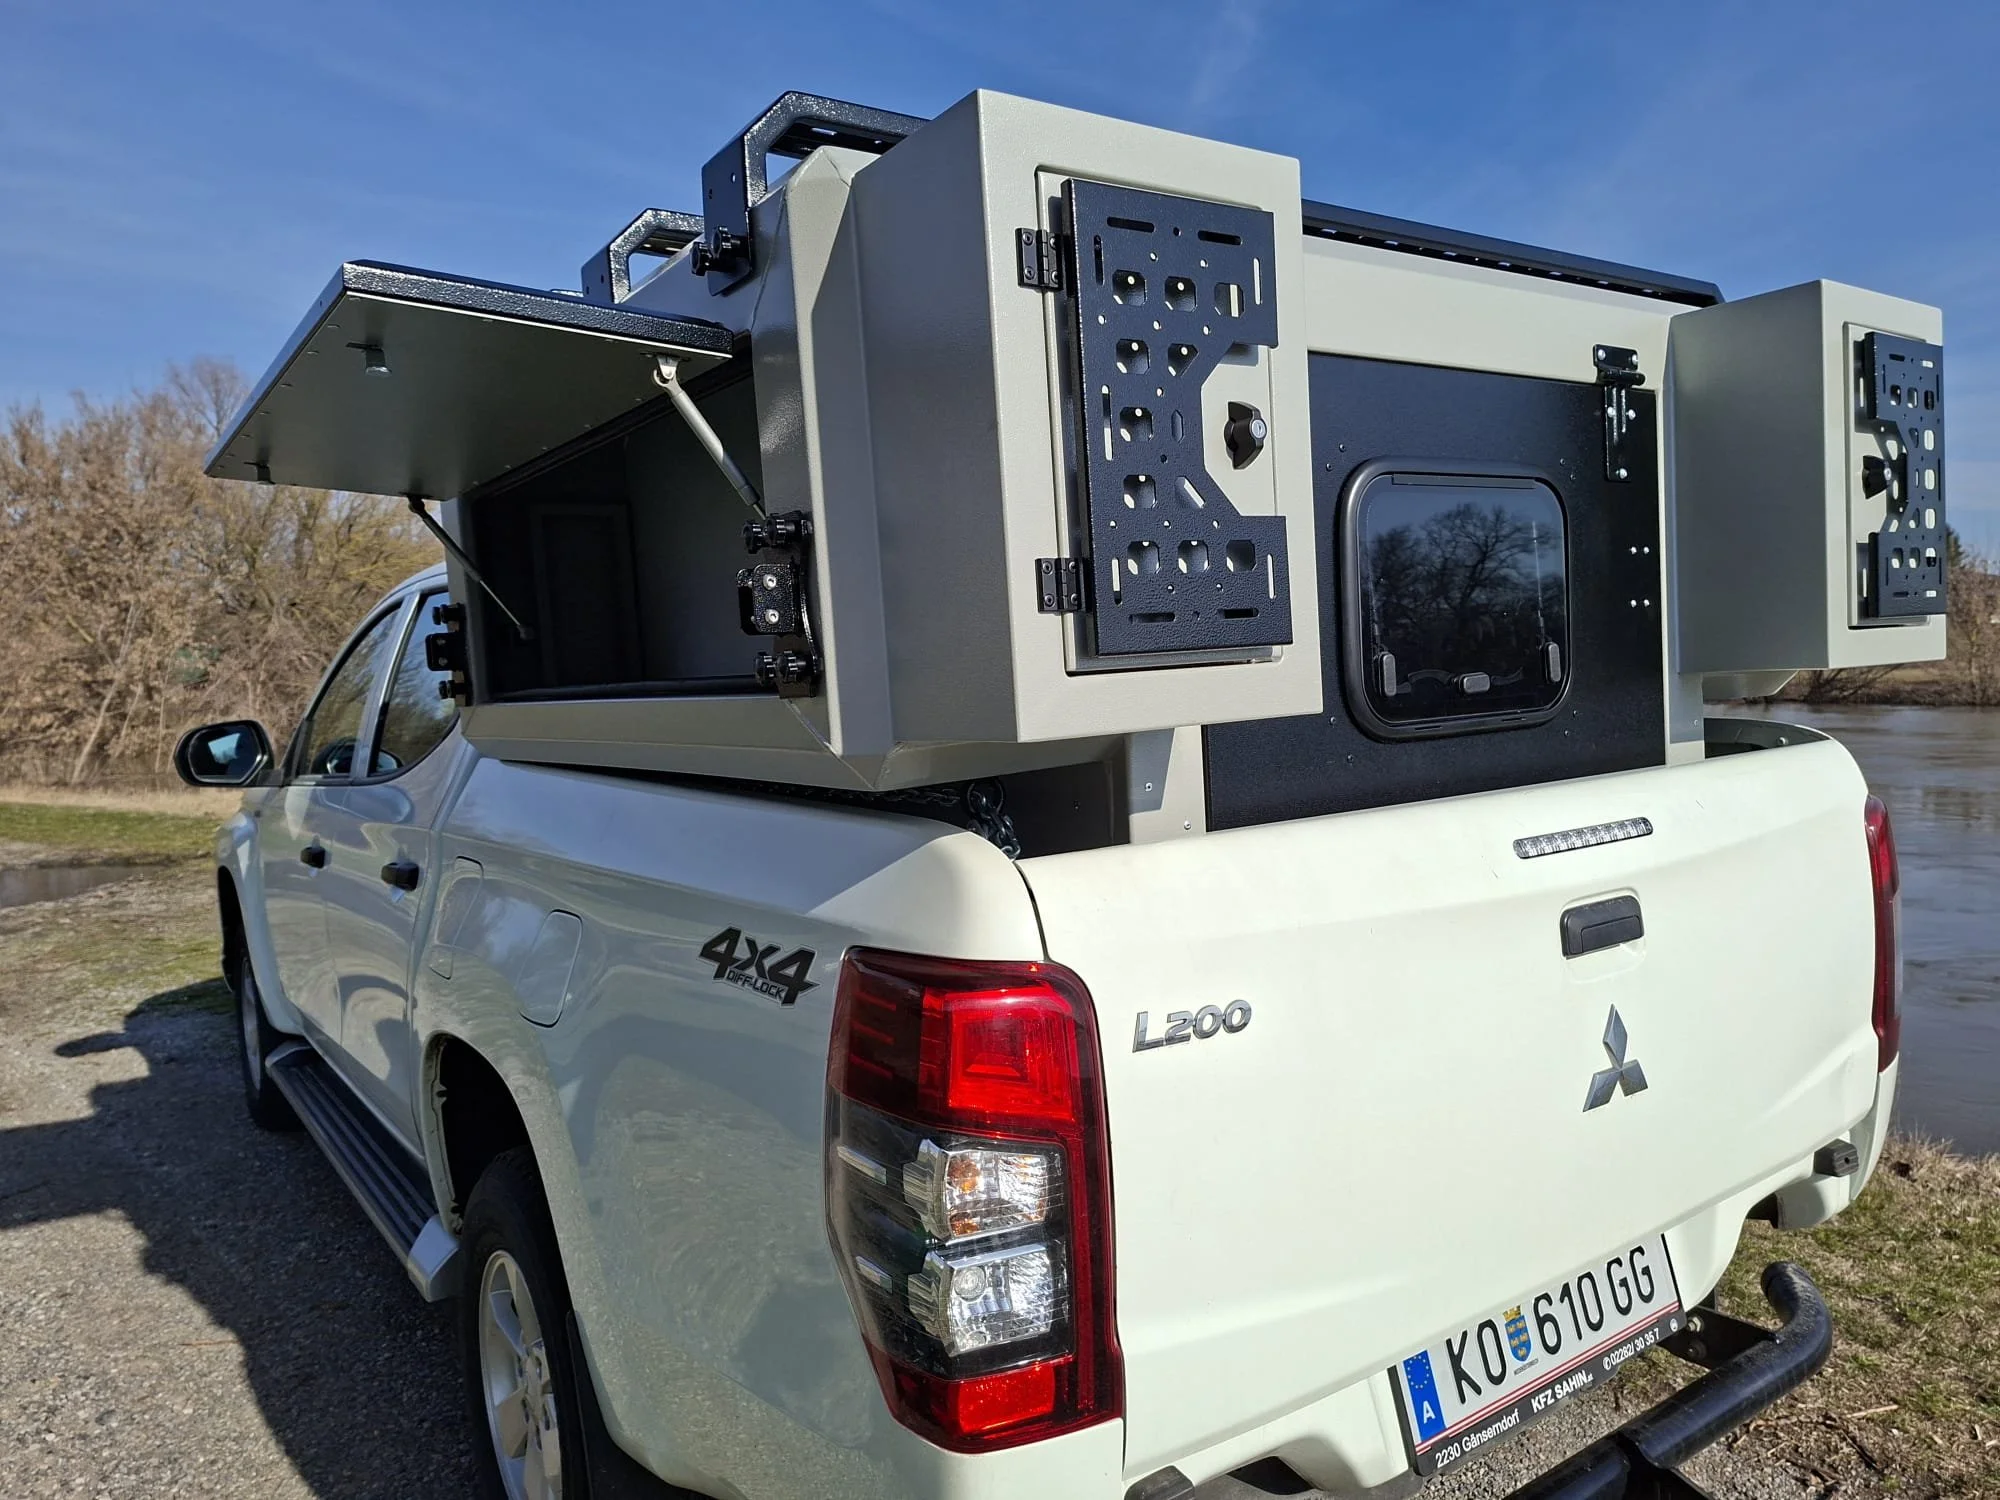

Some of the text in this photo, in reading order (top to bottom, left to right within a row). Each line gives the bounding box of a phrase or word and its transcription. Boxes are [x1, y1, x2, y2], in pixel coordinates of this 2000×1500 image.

[726, 969, 785, 1000] DIFF-LOCK
[1132, 999, 1252, 1053] L200
[1445, 1245, 1655, 1405] KO 610 GG
[1422, 1400, 1436, 1424] A
[1435, 1442, 1461, 1469] 2230
[1462, 1408, 1520, 1452] Gänserndorf
[1531, 1389, 1555, 1413] KFZ
